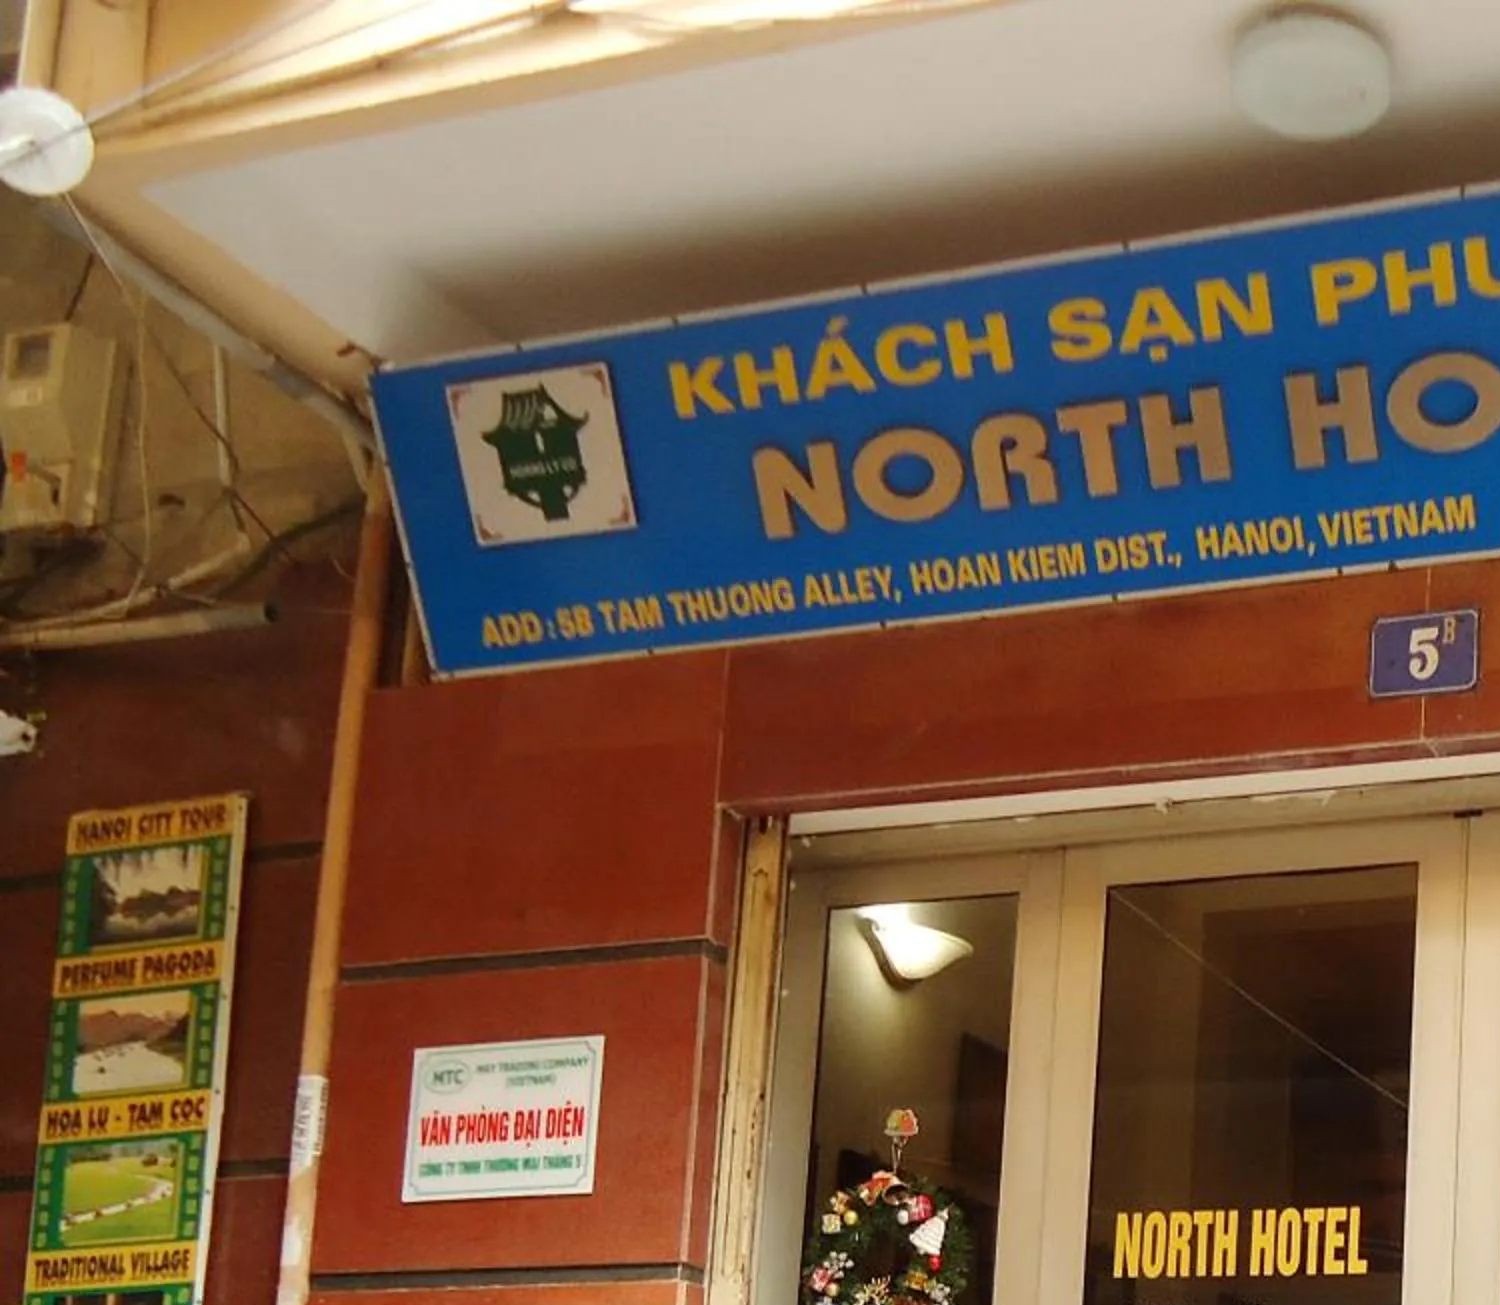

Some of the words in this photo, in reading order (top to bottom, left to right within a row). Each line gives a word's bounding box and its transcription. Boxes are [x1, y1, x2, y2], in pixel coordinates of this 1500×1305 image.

[667, 312, 1015, 420] KHÁCH
[1048, 272, 1274, 363] SẠN
[752, 385, 1232, 540] NORTH
[597, 596, 664, 635] TAM
[666, 576, 797, 625] THUONG
[803, 564, 902, 609] ALLEY,
[909, 552, 1002, 594] HOAN
[1007, 541, 1088, 582] KIEM
[1094, 530, 1182, 573] DIST.,
[1195, 515, 1316, 560] HANOI,
[1317, 493, 1478, 548] VIETNAM
[76, 816, 132, 843] HANOI
[138, 812, 174, 837] CITY
[180, 803, 227, 833] TOUR
[60, 957, 138, 989] PERFUME
[143, 946, 216, 979] PAGODA
[46, 1108, 83, 1133] HOA
[88, 1106, 110, 1129] LU
[127, 1101, 164, 1126] TAM
[170, 1096, 206, 1122] COC
[35, 1253, 126, 1282] TRADITIONAL
[130, 1248, 191, 1274] VILLAGE
[1113, 1209, 1239, 1279] NORTH
[1249, 1206, 1369, 1277] HOTEL
